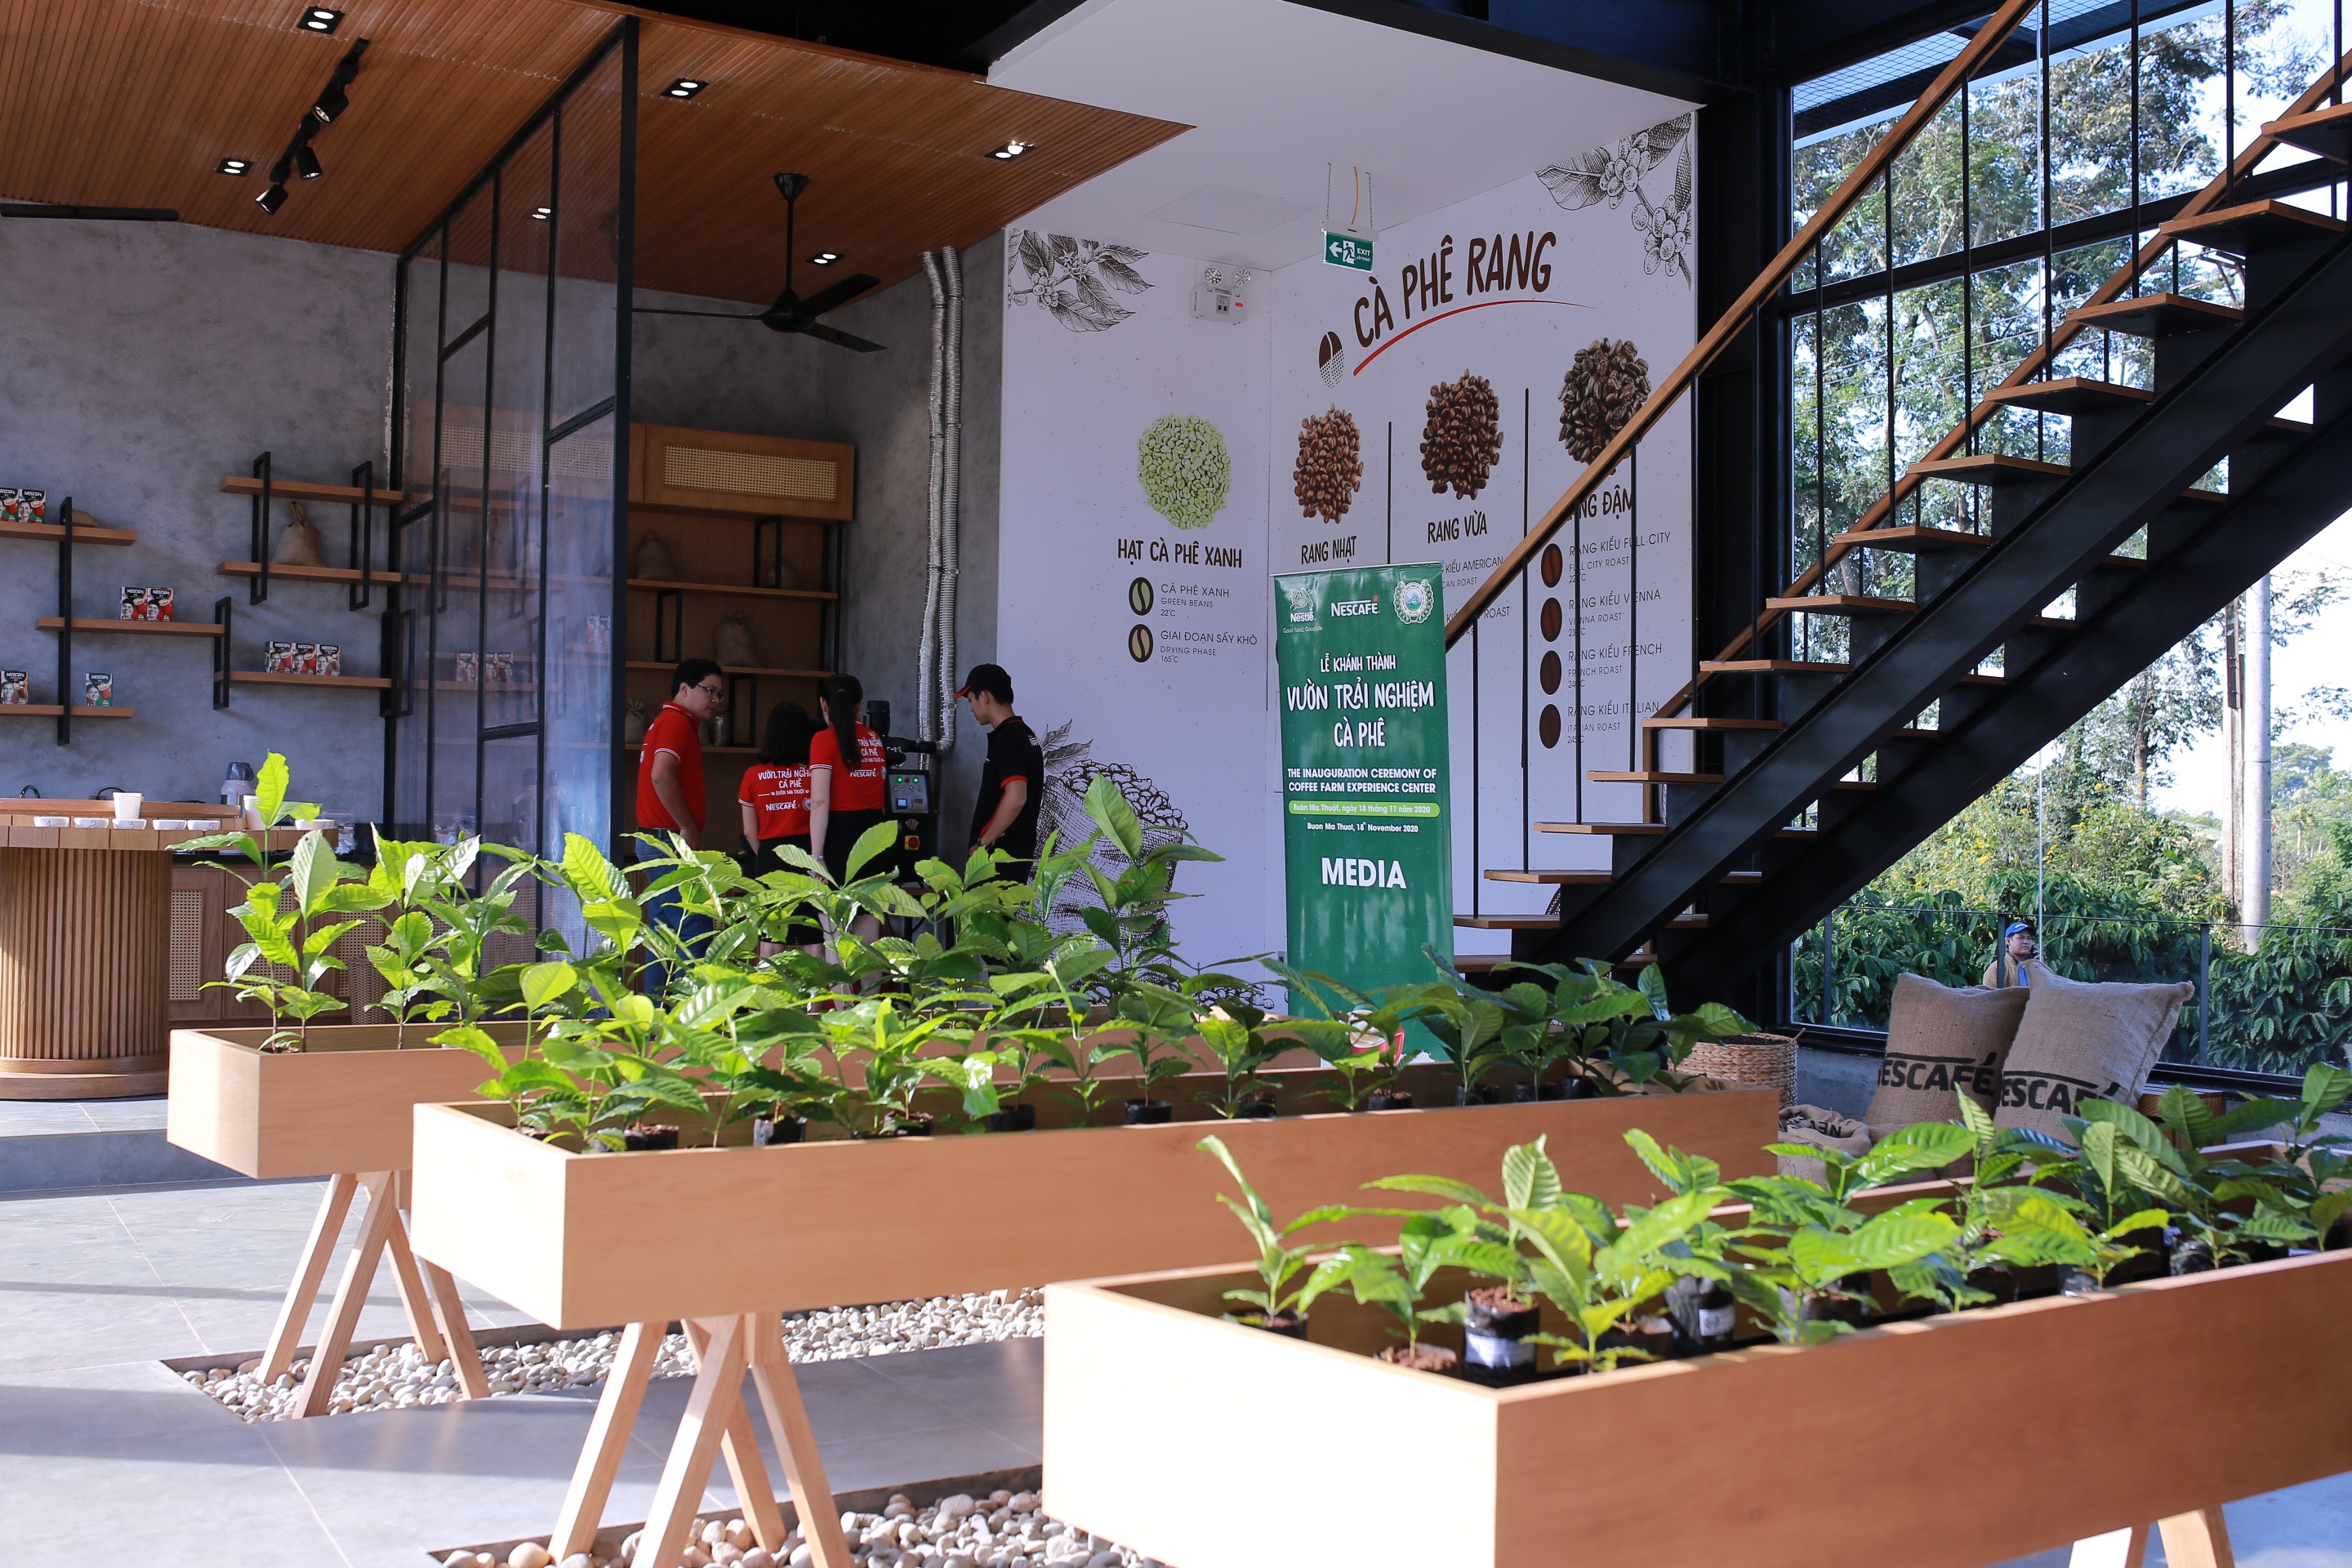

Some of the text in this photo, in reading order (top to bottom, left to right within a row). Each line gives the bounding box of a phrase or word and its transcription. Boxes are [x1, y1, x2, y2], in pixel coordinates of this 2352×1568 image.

[1354, 230, 1557, 347] CÀ PHÊ RANG
[1428, 510, 1487, 543] RANG VỪA
[1301, 535, 1356, 564] RANG NHẠT
[1570, 542, 1597, 556] RNG
[1601, 536, 1620, 552] KIỂU
[1649, 532, 1671, 545] CITY
[1117, 537, 1242, 568] HẠT CÀ PHÊ XANH
[1446, 559, 1460, 573] KIỂU
[1463, 556, 1503, 571] AMERICAN
[1569, 556, 1629, 572] FL CITY ROAST
[1160, 582, 1229, 598] CÀ PHÊ XANH
[1457, 577, 1477, 587] ROAST
[1160, 598, 1214, 608] GREEN BEANS
[1331, 595, 1379, 617] NESCAFÉ
[1569, 590, 1661, 610] RNG KIỂU VENNA
[1290, 612, 1315, 622] Nestlé
[1484, 606, 1510, 619] ROAST
[1569, 612, 1622, 626] VINNA ROAST
[1160, 630, 1258, 645] GIAI ĐOẠN SẤY KHÔ
[1160, 646, 1216, 656] DRYING PHASE
[1599, 643, 1619, 659] KIỂU
[1321, 652, 1396, 673] LỄ KHÁNH THÀNH
[1568, 665, 1622, 677] FRNCH ROAST
[1568, 679, 1585, 688] 24C
[1287, 679, 1328, 711] VƯỜN
[1334, 677, 1368, 710] TRẢI
[1599, 700, 1619, 715] KIỂU
[1622, 702, 1659, 714] ITLIAN
[1334, 715, 1386, 747] CÀ PHÊ
[1567, 723, 1620, 733] ITAIAN ROAST
[1288, 768, 1437, 779] THE INAUGURATION CEREMONY OF
[778, 778, 802, 789] CÀ PHÊ
[1289, 782, 1437, 794] COFFEE FARM EXPERIENCE CENTER
[1321, 804, 1341, 813] Thuột,
[1342, 804, 1357, 813] ngày
[1368, 804, 1388, 814] tháng
[1325, 822, 1335, 831] Ma
[1337, 823, 1356, 832] Thuot,
[1368, 824, 1402, 832] November
[1321, 858, 1407, 889] MEDIA
[1878, 1052, 1997, 1097] ESCAFÉ
[2000, 1070, 2120, 1116] ESCAF
